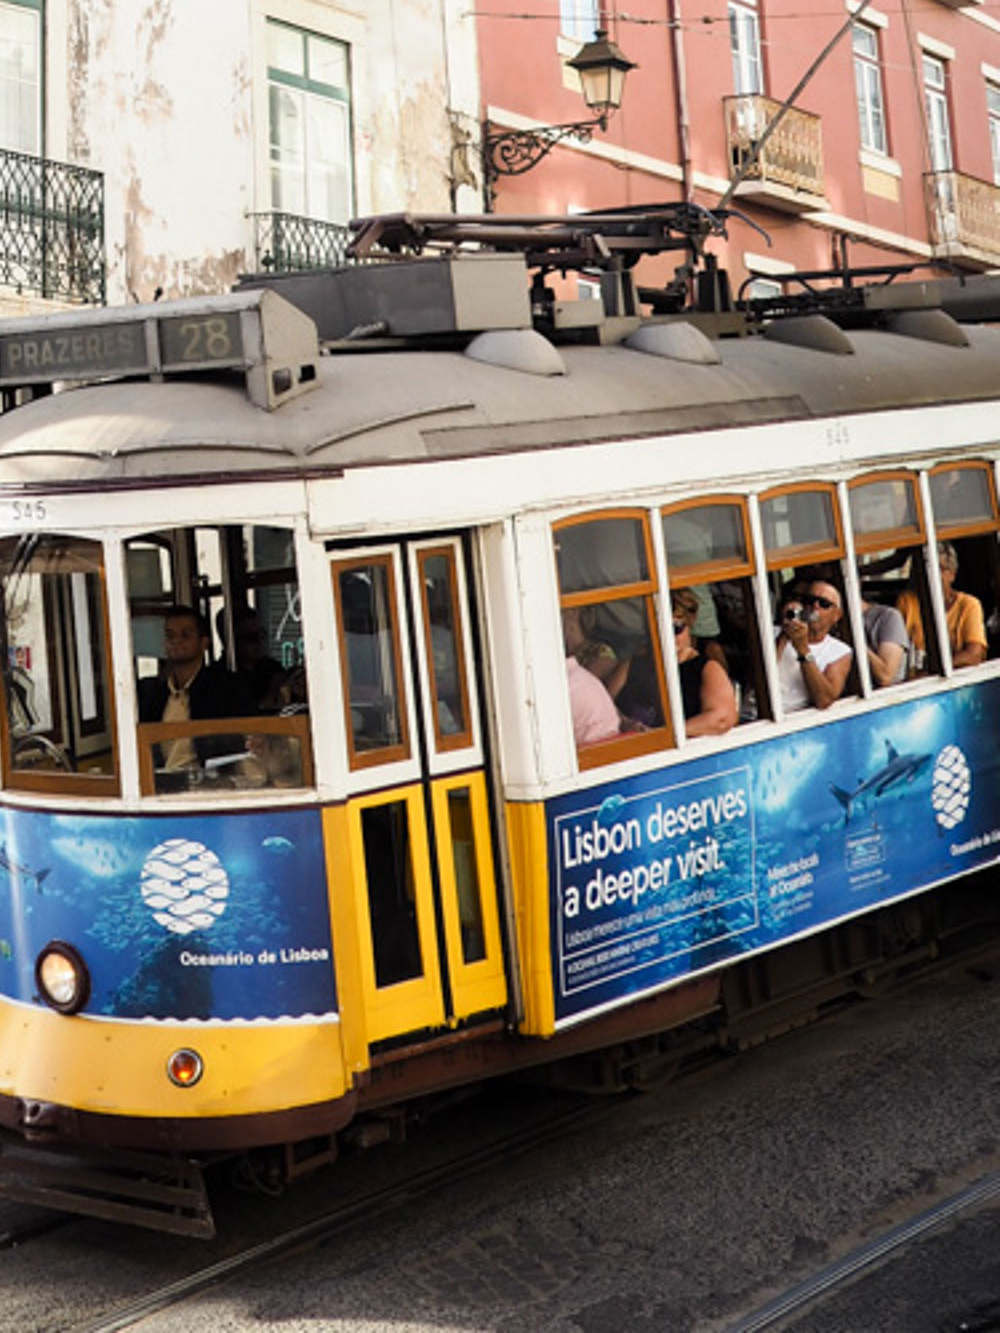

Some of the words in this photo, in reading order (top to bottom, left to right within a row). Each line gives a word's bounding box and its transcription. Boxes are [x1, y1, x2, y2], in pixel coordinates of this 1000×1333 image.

[6, 330, 134, 369] PRAZERES
[180, 318, 231, 361] 28
[562, 818, 641, 869] Lisbon
[647, 788, 748, 843] deserves
[564, 885, 580, 918] a
[585, 857, 672, 906] deeper
[677, 835, 726, 881] visit.
[180, 950, 254, 966] Oceanário
[258, 949, 276, 964] de
[280, 946, 329, 963] Lisboa
